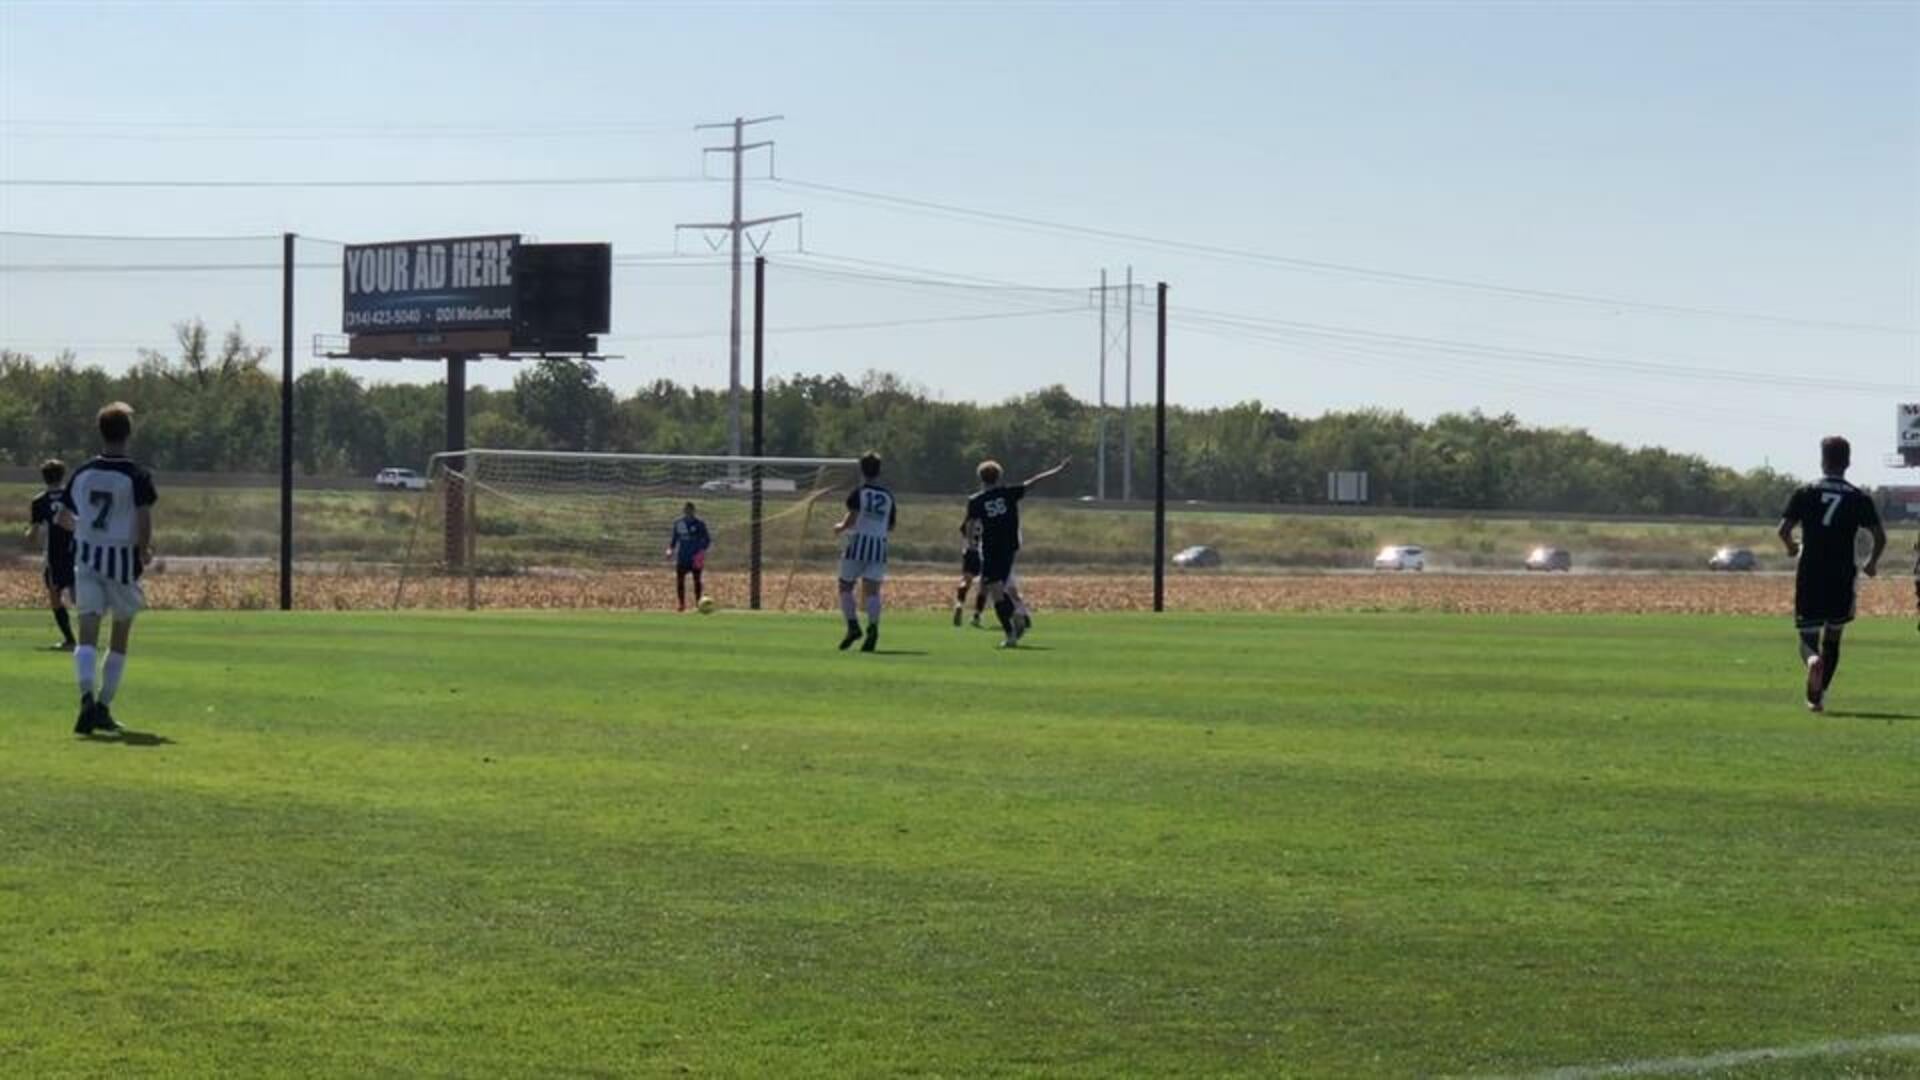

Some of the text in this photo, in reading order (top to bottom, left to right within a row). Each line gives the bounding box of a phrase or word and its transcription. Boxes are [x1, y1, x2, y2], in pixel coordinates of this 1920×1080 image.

[347, 240, 512, 294] YOUR AD HERE
[90, 490, 113, 529] 7
[865, 491, 887, 516] 12
[984, 498, 1007, 518] 56
[1821, 493, 1841, 526] 7
